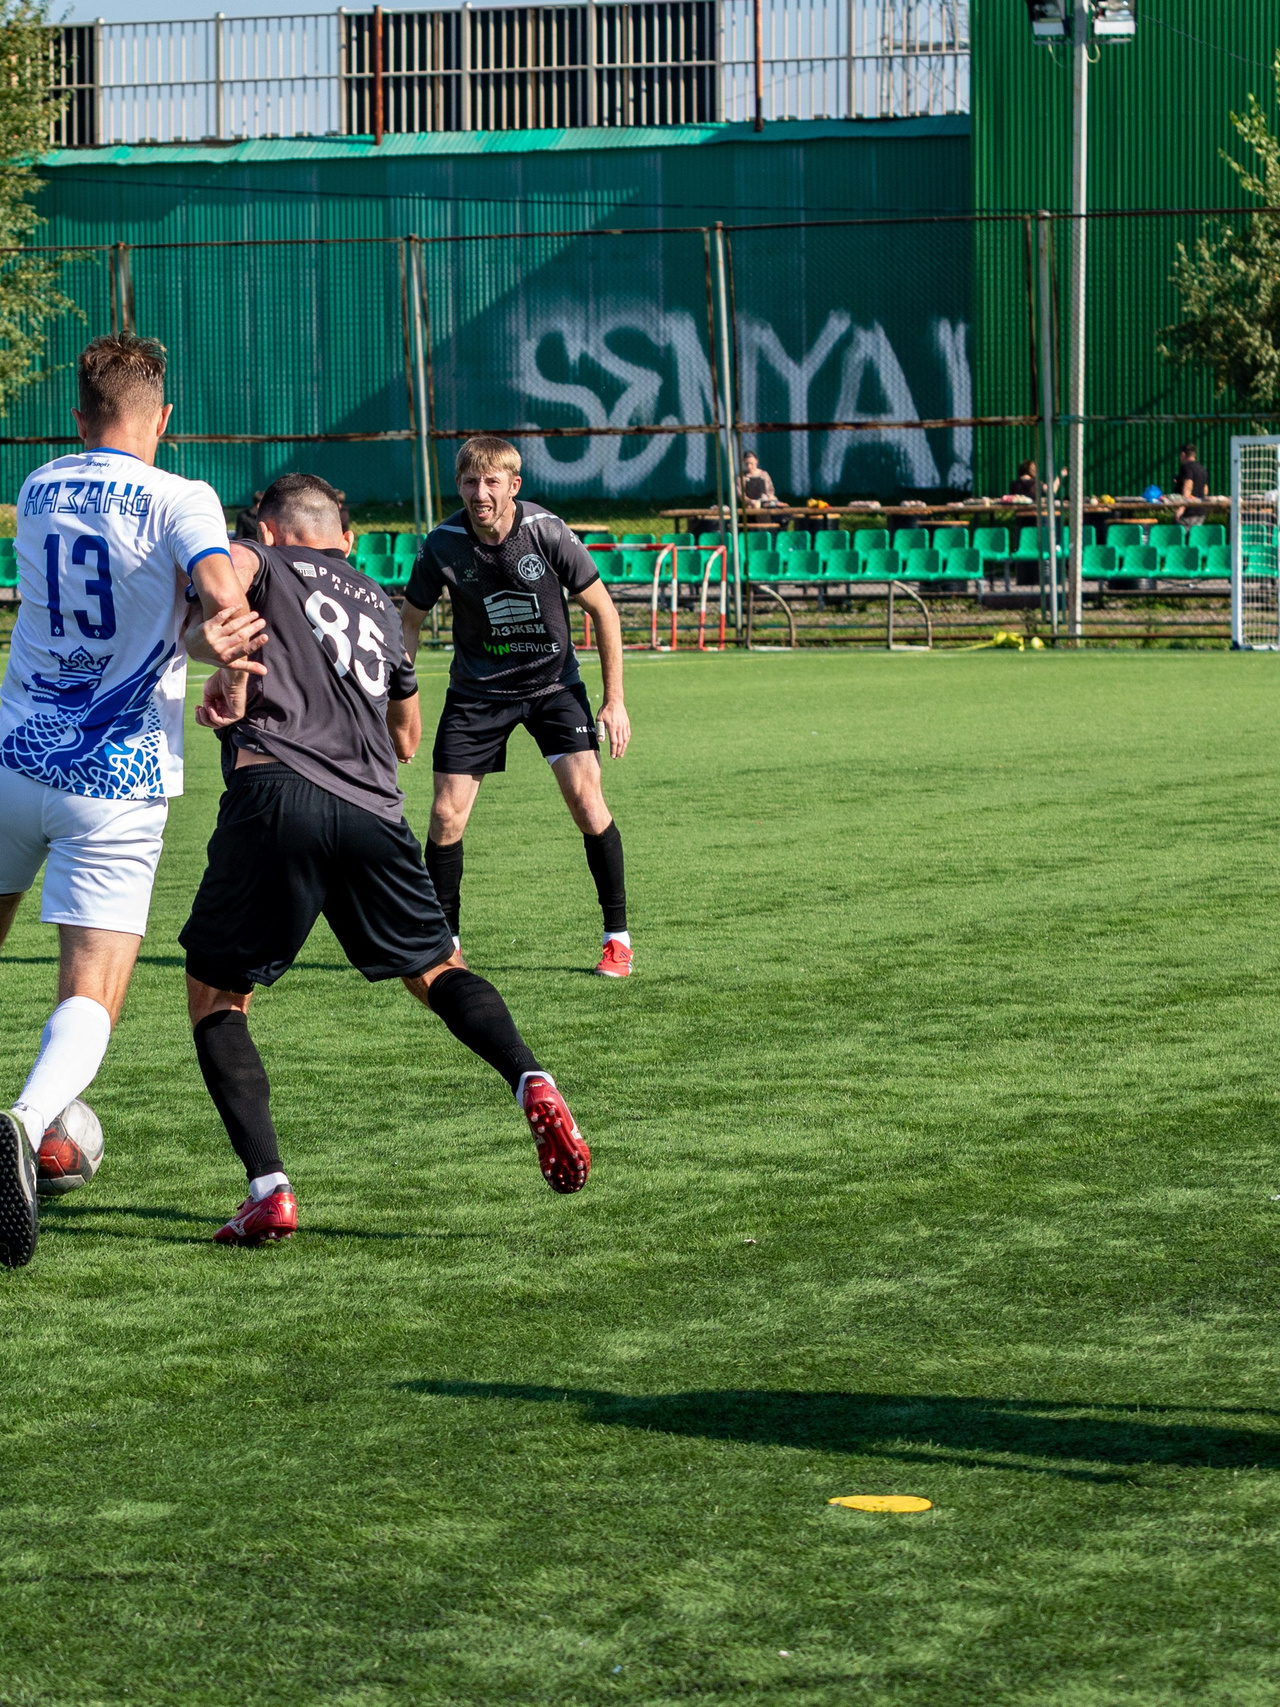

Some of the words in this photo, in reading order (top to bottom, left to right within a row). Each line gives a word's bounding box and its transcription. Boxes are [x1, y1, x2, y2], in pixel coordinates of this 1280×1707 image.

[24, 481, 152, 517] КАЗАНЬ
[43, 534, 116, 640] 13
[304, 590, 387, 697] 85
